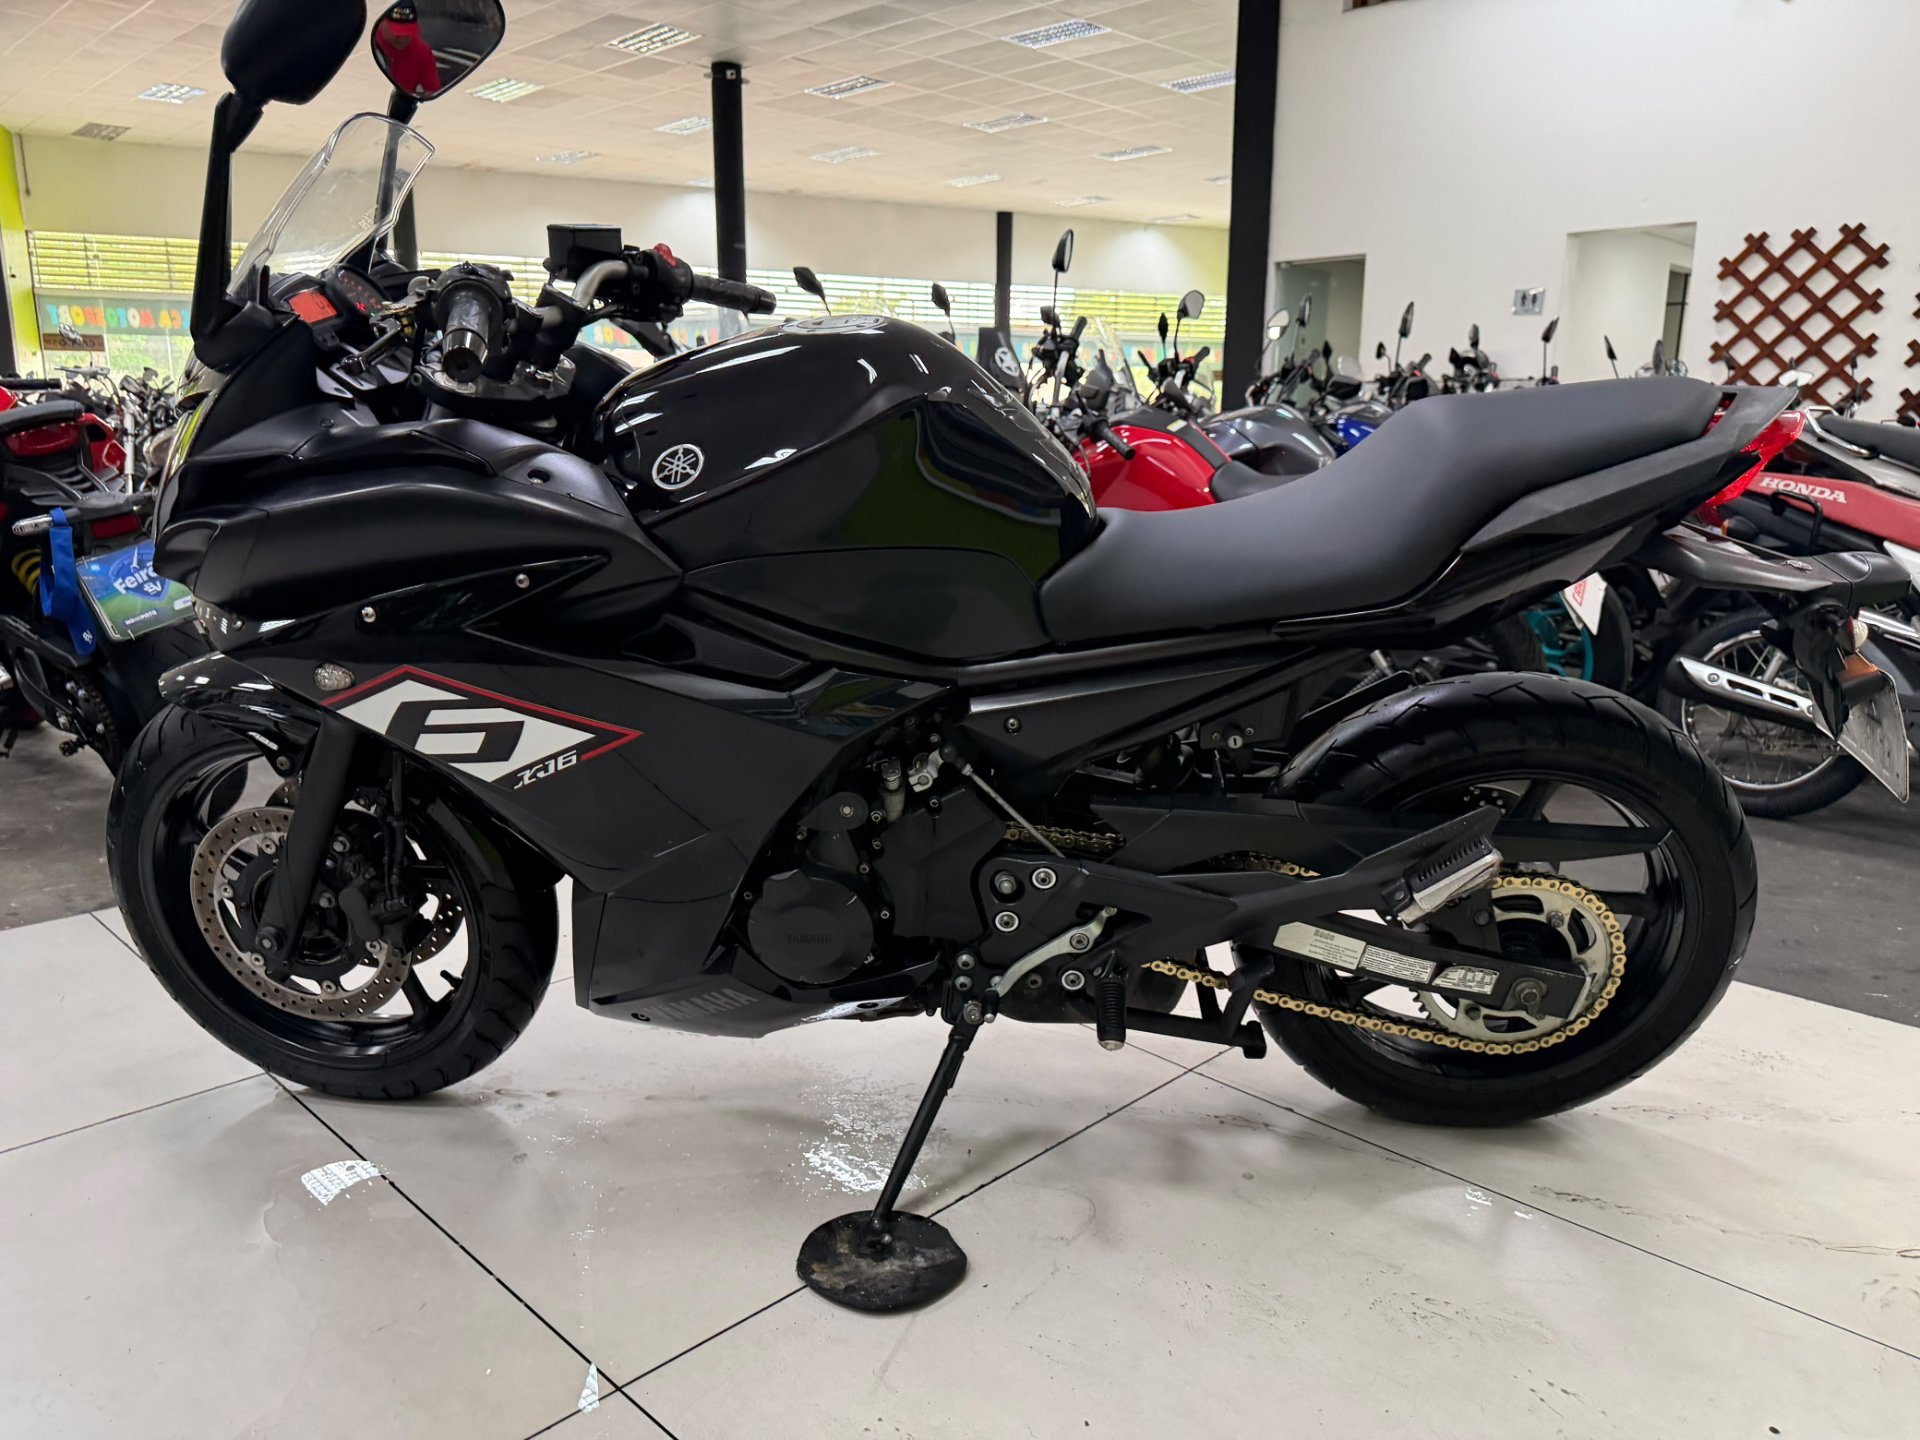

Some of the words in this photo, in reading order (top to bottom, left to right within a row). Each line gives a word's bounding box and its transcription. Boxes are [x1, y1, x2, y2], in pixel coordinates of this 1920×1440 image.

[1759, 477, 1847, 504] HONDA
[513, 750, 577, 789] XJ6
[645, 987, 759, 1020] YAMAHA
